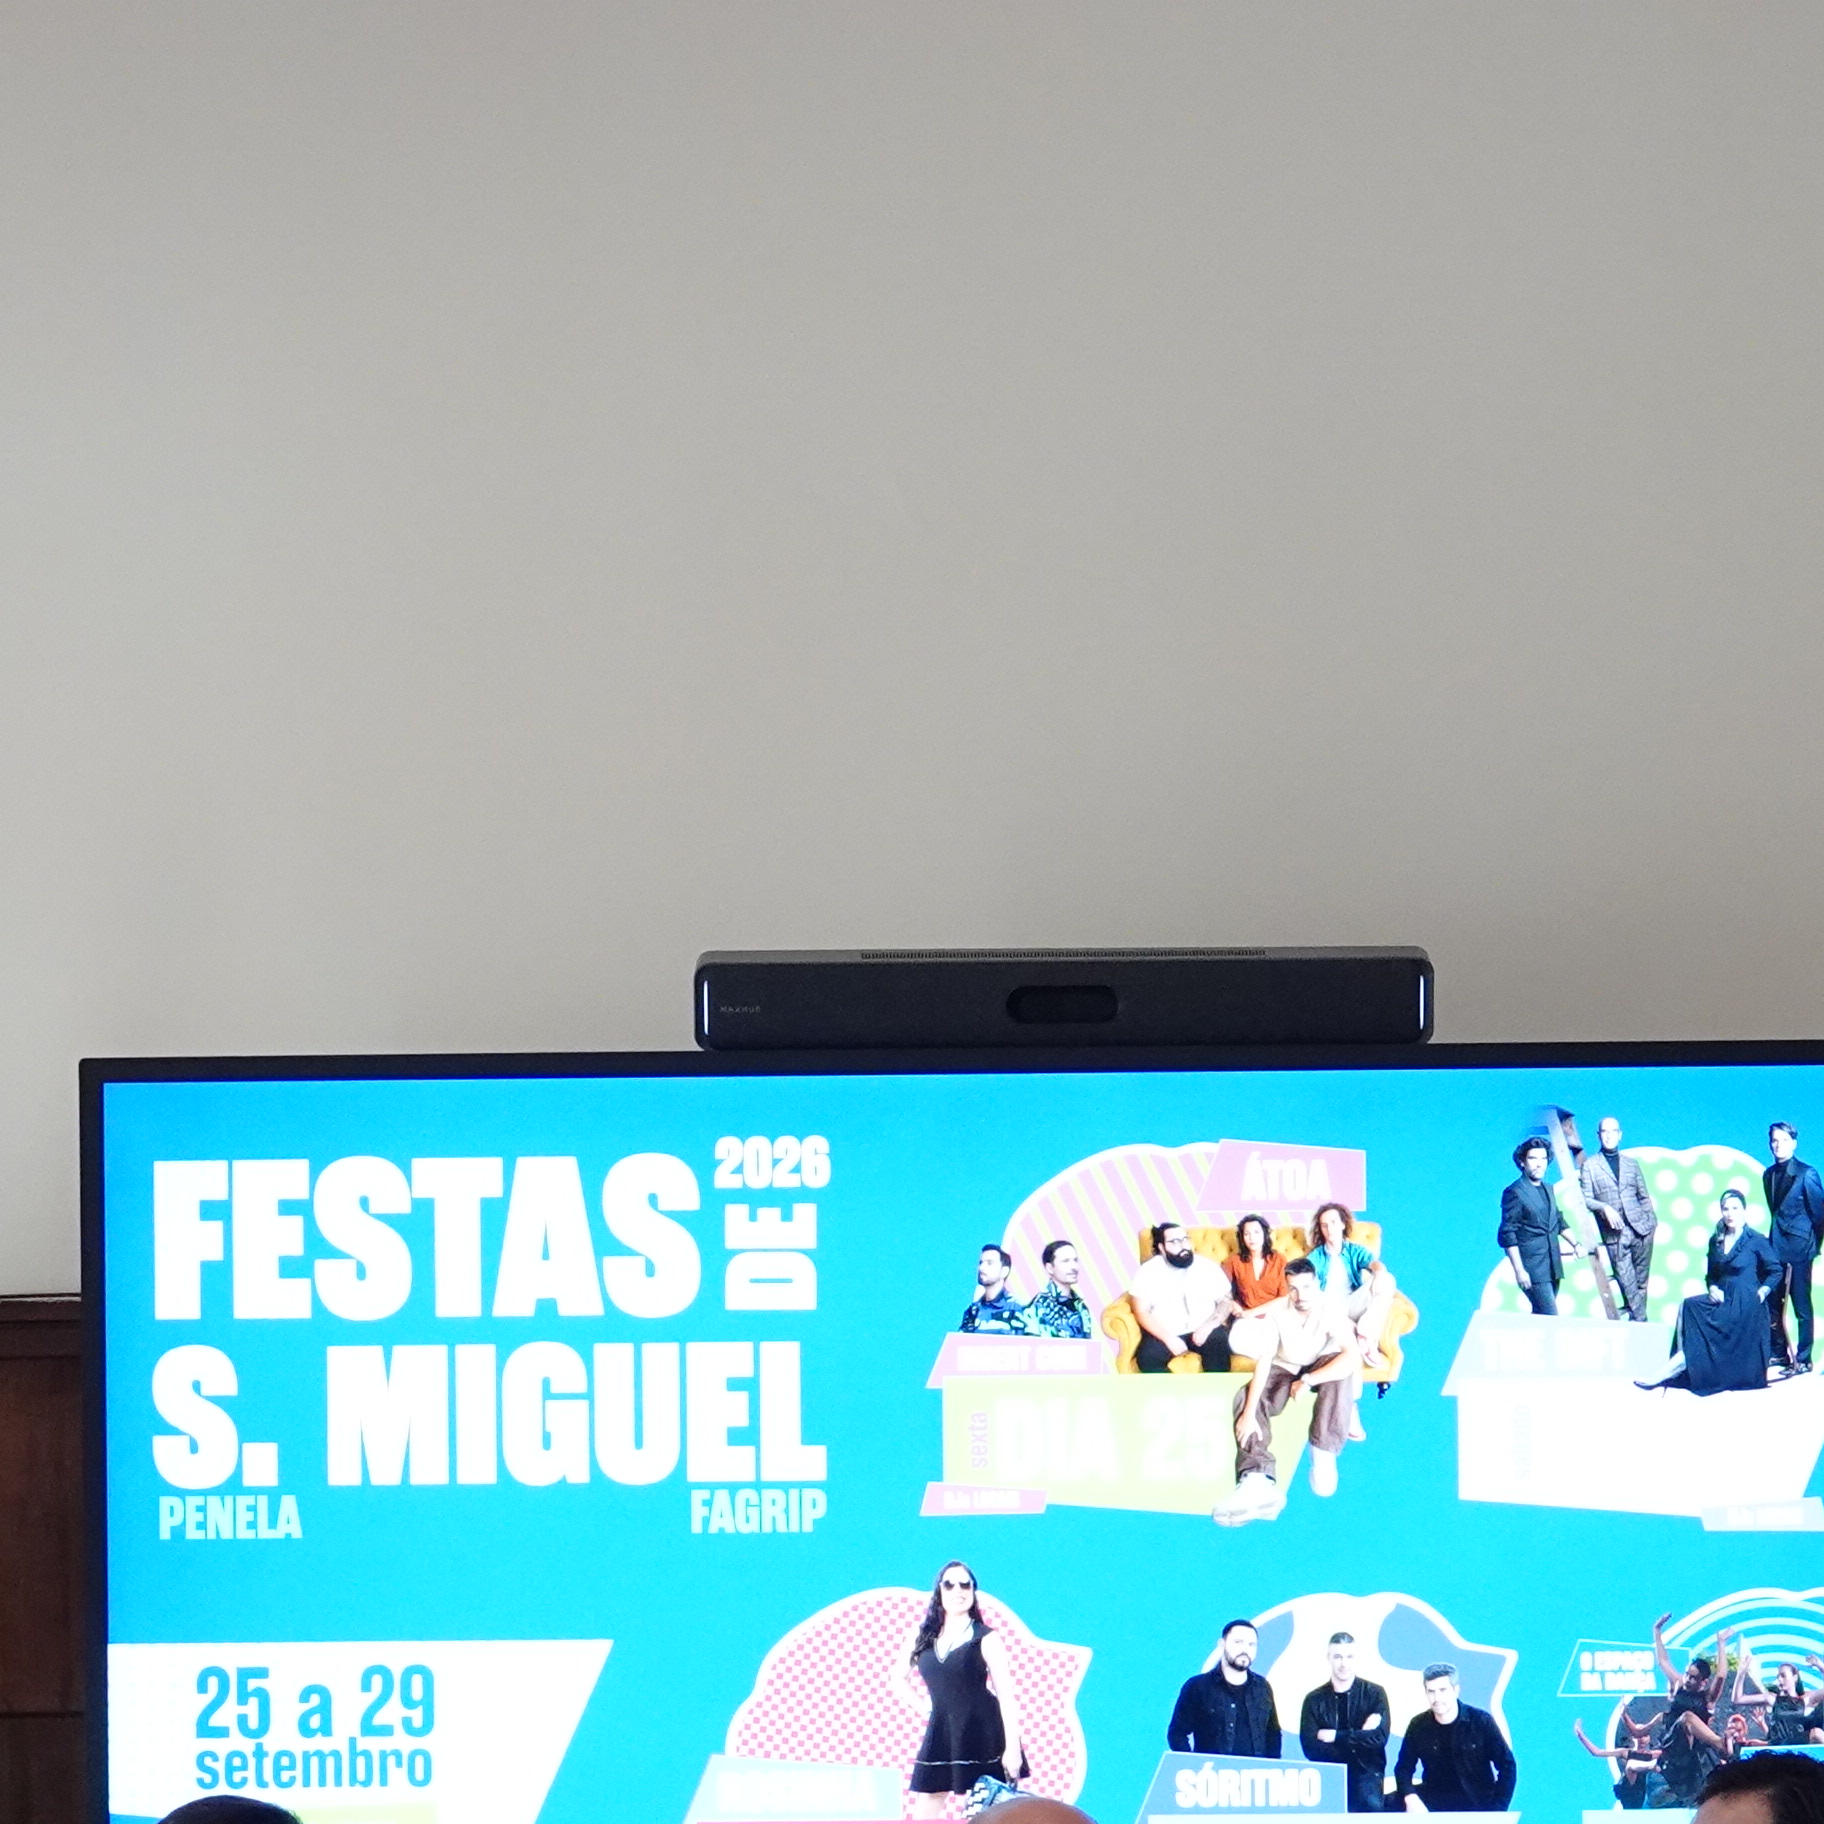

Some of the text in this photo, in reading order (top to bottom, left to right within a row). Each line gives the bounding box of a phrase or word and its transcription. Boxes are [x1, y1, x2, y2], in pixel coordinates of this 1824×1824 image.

[713, 1135, 832, 1189] 2026
[1241, 1151, 1333, 1201] ÁTOA
[153, 1152, 701, 1321] FESTAS
[724, 1203, 818, 1310] DE
[151, 1341, 827, 1489] S. MIGUEL
[969, 1411, 988, 1470] sexta
[994, 1396, 1121, 1484] DIA
[159, 1494, 303, 1540] PENELA
[690, 1489, 828, 1534] FAGRIP
[195, 1664, 436, 1739] 25 a 29
[195, 1736, 433, 1789] setembro
[1175, 1761, 1322, 1808] SÓRITMO
